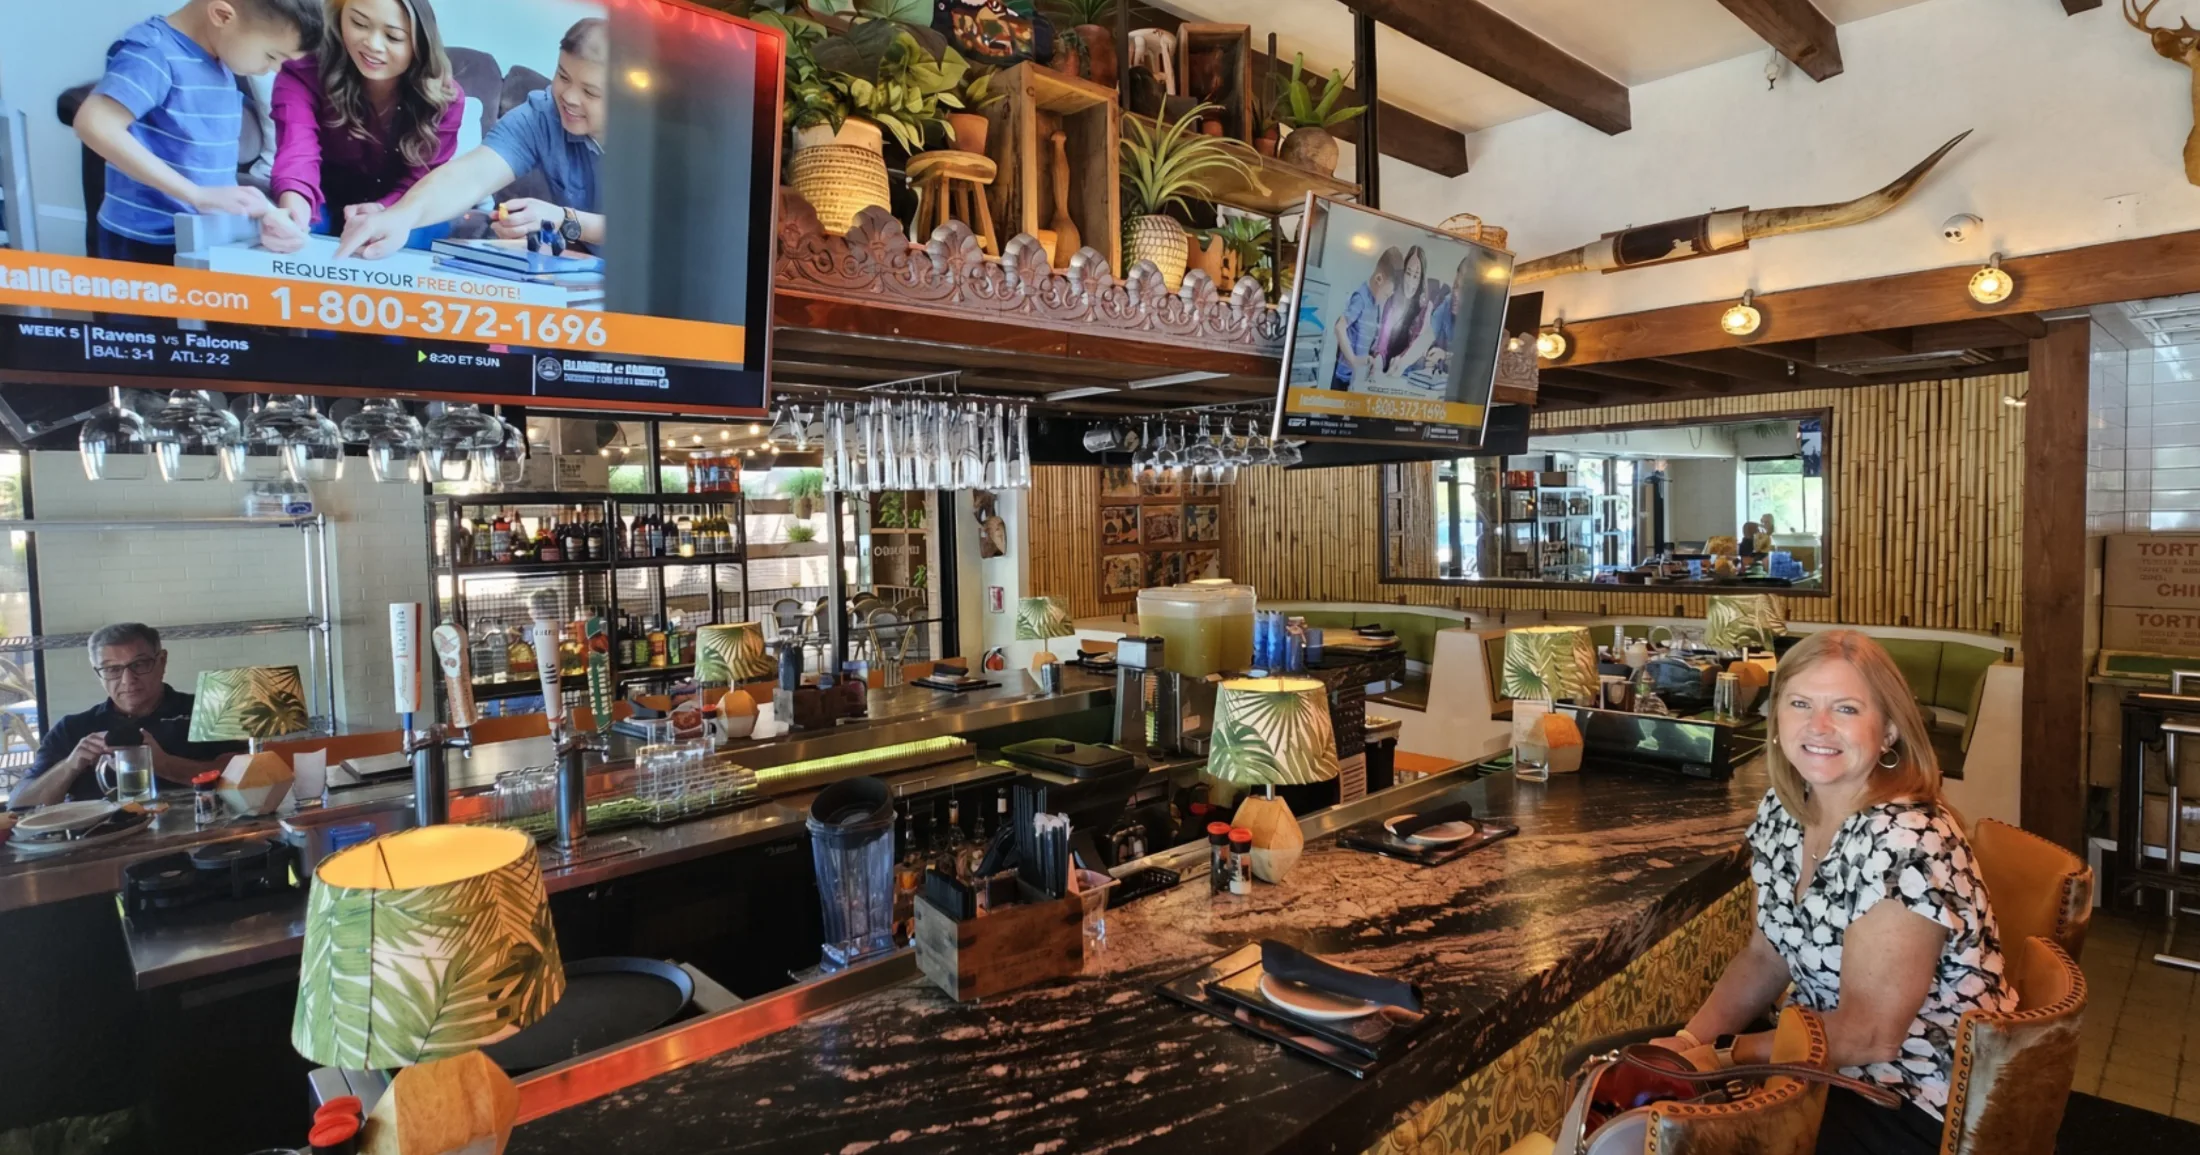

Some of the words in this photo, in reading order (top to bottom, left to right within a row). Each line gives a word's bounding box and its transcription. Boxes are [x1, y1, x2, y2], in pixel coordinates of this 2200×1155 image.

[273, 260, 359, 281] REQUEST
[363, 270, 413, 288] YOUR
[417, 276, 457, 293] FREE
[460, 281, 521, 299] QUOTE!
[270, 286, 607, 346] 1-800-372-1696
[19, 324, 67, 338] WEEK
[92, 326, 155, 343] Ravens
[162, 335, 180, 346] vs
[185, 333, 250, 351] Falcons
[92, 345, 128, 359] BAL:
[131, 348, 154, 361] 3-1
[170, 350, 203, 363] ATL:
[206, 352, 230, 366] 2-2
[429, 352, 456, 364] 8:20
[458, 354, 474, 366] ET
[475, 356, 501, 368] SUN
[2157, 583, 2200, 597] CHI
[2136, 614, 2200, 628] TORT
